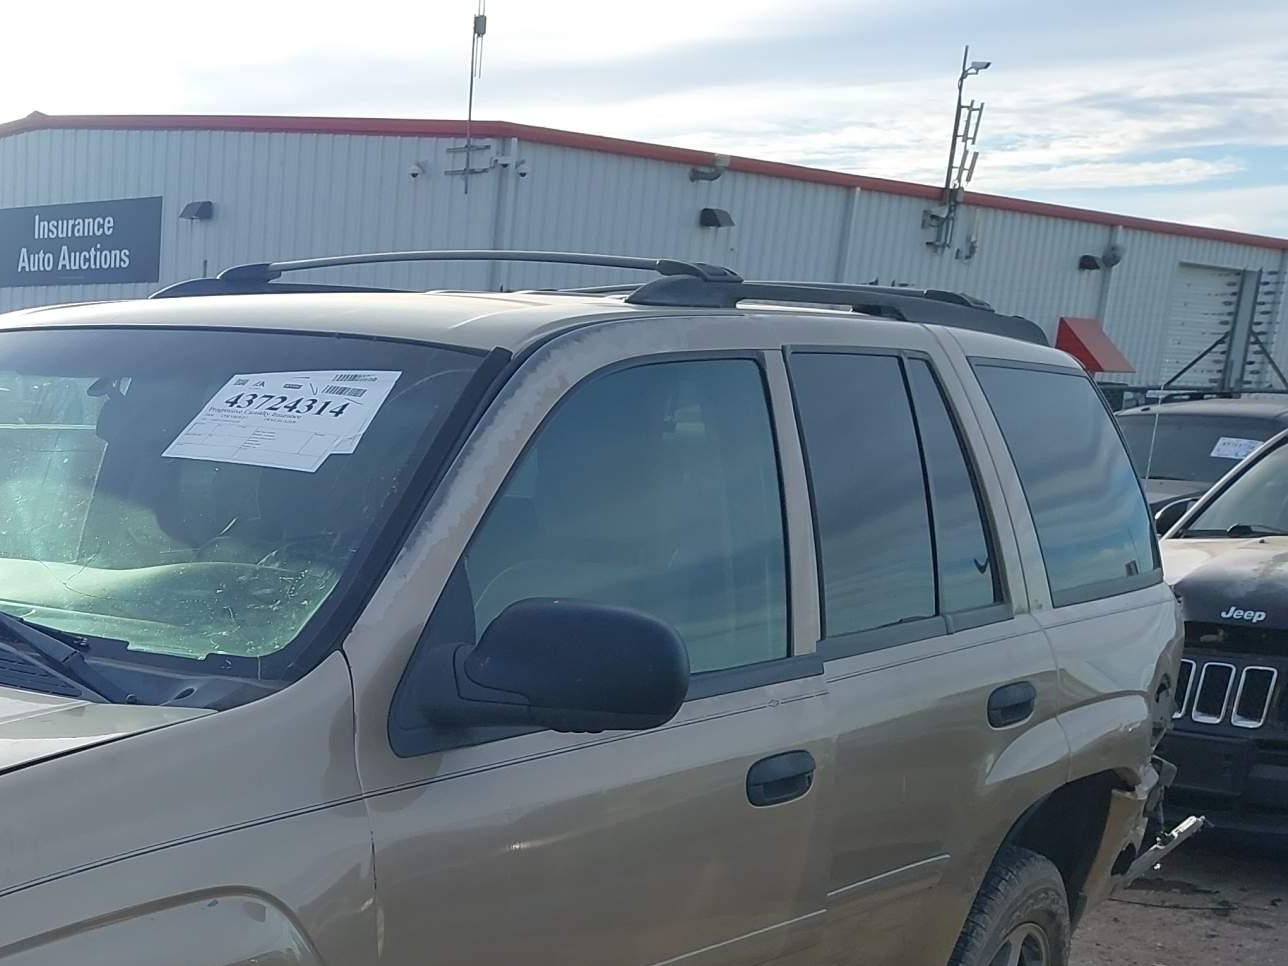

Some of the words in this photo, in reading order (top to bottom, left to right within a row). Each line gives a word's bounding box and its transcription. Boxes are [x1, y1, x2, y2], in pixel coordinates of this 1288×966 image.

[34, 214, 114, 239] Insurance
[18, 247, 54, 272] Auto
[58, 243, 130, 271] Auctions
[225, 391, 349, 417] 43724314
[1220, 606, 1267, 623] Jeep
